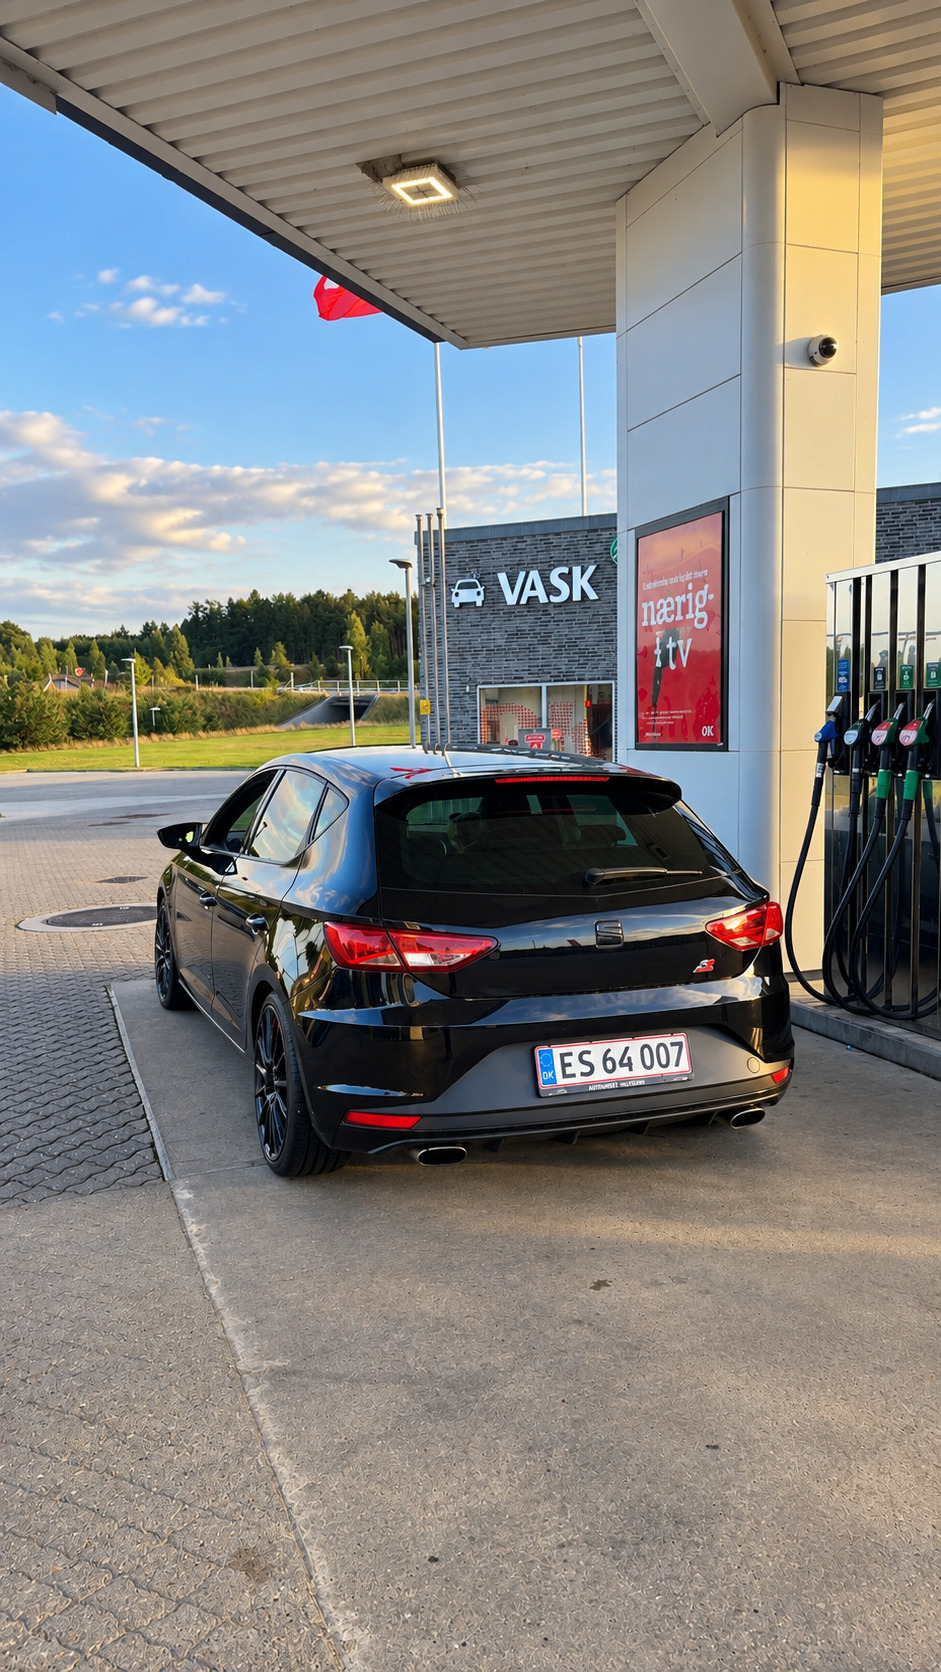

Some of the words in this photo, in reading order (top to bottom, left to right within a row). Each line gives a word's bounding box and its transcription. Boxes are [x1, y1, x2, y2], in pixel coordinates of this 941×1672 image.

[497, 564, 599, 606] VASK
[701, 725, 714, 737] OK
[559, 1049, 595, 1079] ES
[602, 1046, 634, 1074] 64
[639, 1041, 684, 1070] 007
[542, 1071, 555, 1080] DK
